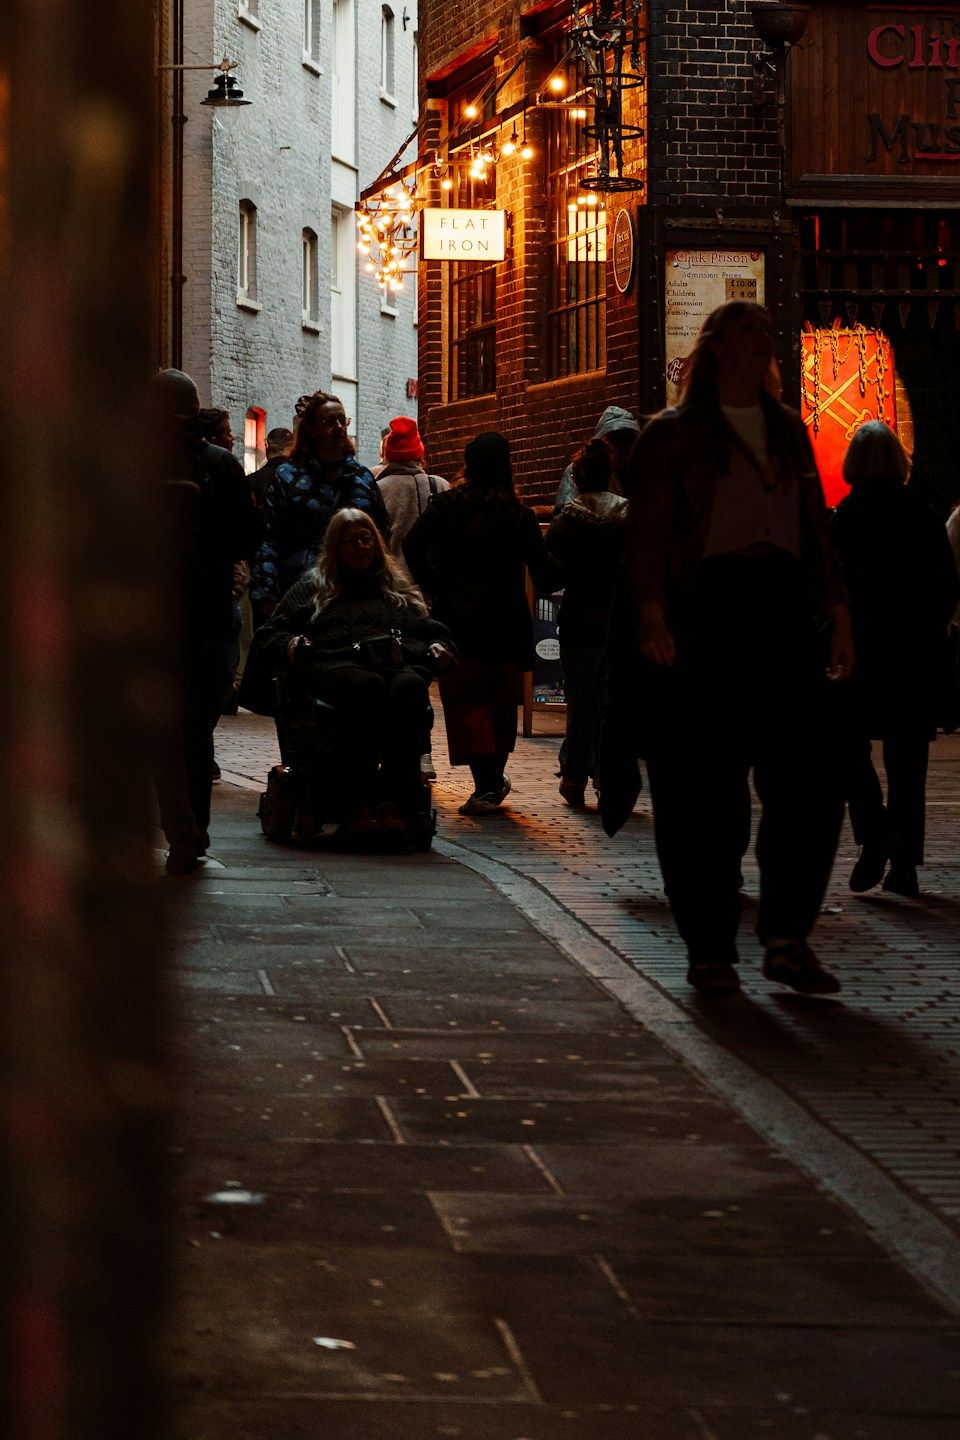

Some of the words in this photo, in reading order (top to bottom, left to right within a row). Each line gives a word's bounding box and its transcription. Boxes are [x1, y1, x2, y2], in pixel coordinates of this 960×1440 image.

[440, 217, 489, 230] FLAT
[440, 239, 490, 251] IRON
[676, 251, 706, 263] Clink
[711, 252, 748, 264] Prison
[730, 280, 757, 288] £10.00
[667, 299, 703, 307] Concession
